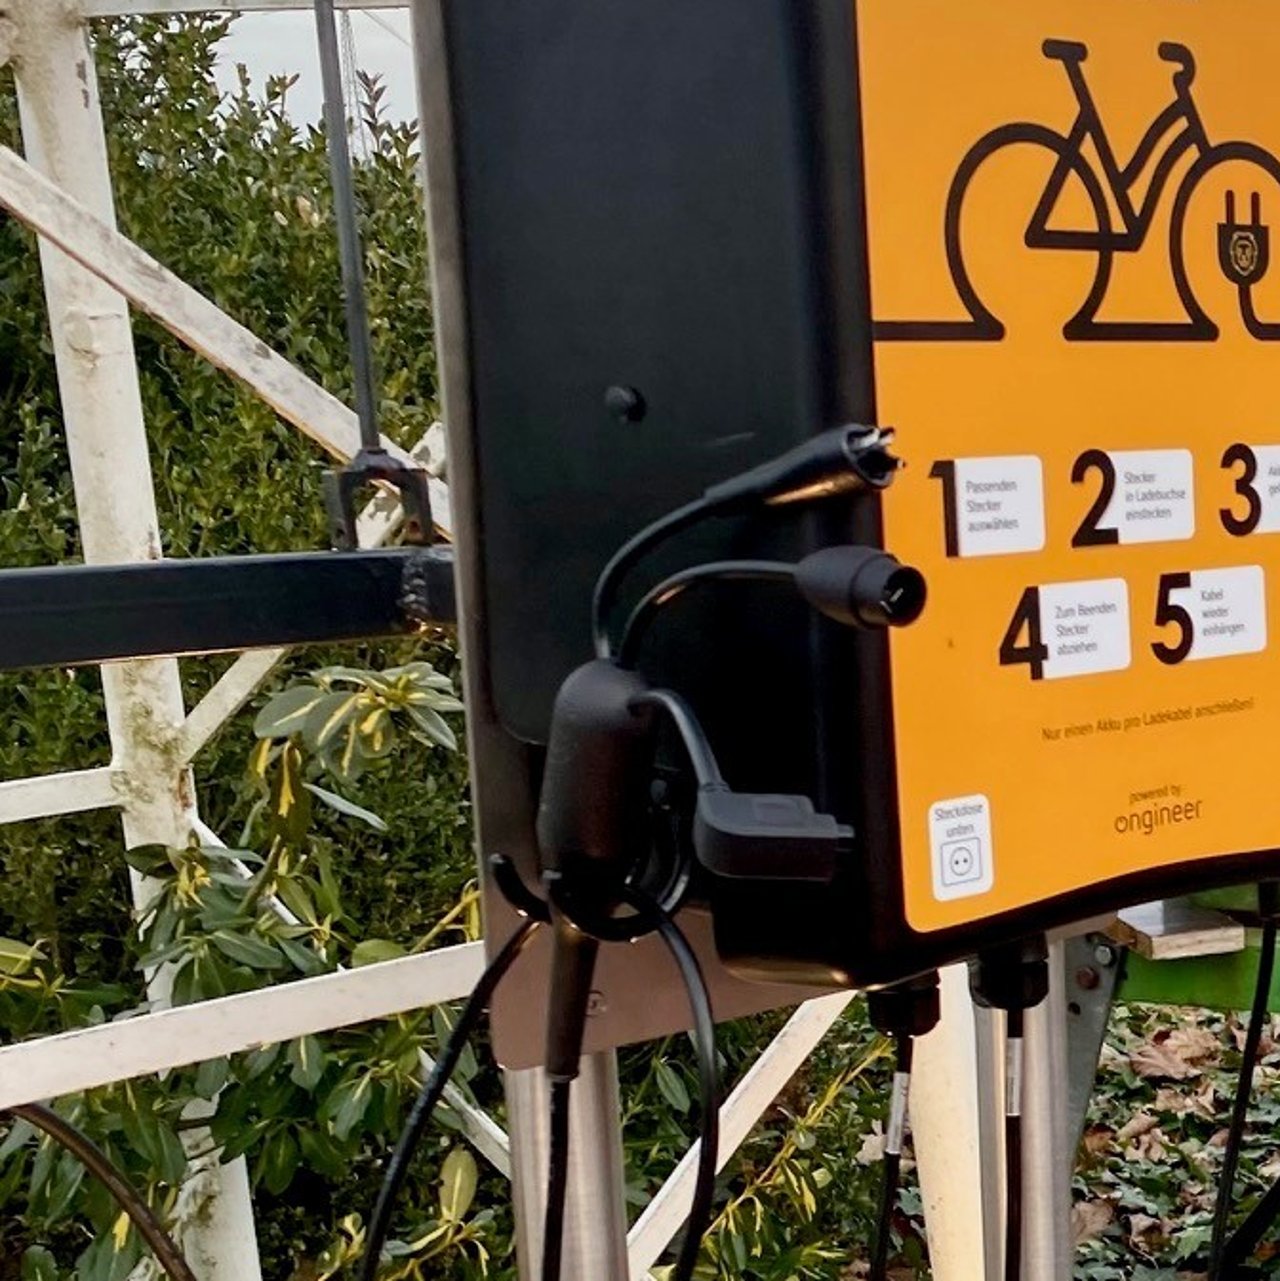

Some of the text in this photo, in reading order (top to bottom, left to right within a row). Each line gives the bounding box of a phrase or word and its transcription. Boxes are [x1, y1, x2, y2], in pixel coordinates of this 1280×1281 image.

[1124, 471, 1156, 484] Stecker
[966, 480, 1018, 493] Passenden
[1219, 443, 1262, 537] 3
[966, 500, 1001, 512] Stecker
[1072, 448, 1119, 548] 2
[928, 460, 959, 557] 1
[1201, 589, 1224, 601] Kabel
[1056, 602, 1117, 619] Zum Beenden
[1150, 572, 1194, 665] 5
[999, 585, 1048, 681] 4
[1056, 624, 1090, 637] Stecker
[1041, 728, 1061, 741] Nur
[1114, 800, 1203, 835] ongineer
